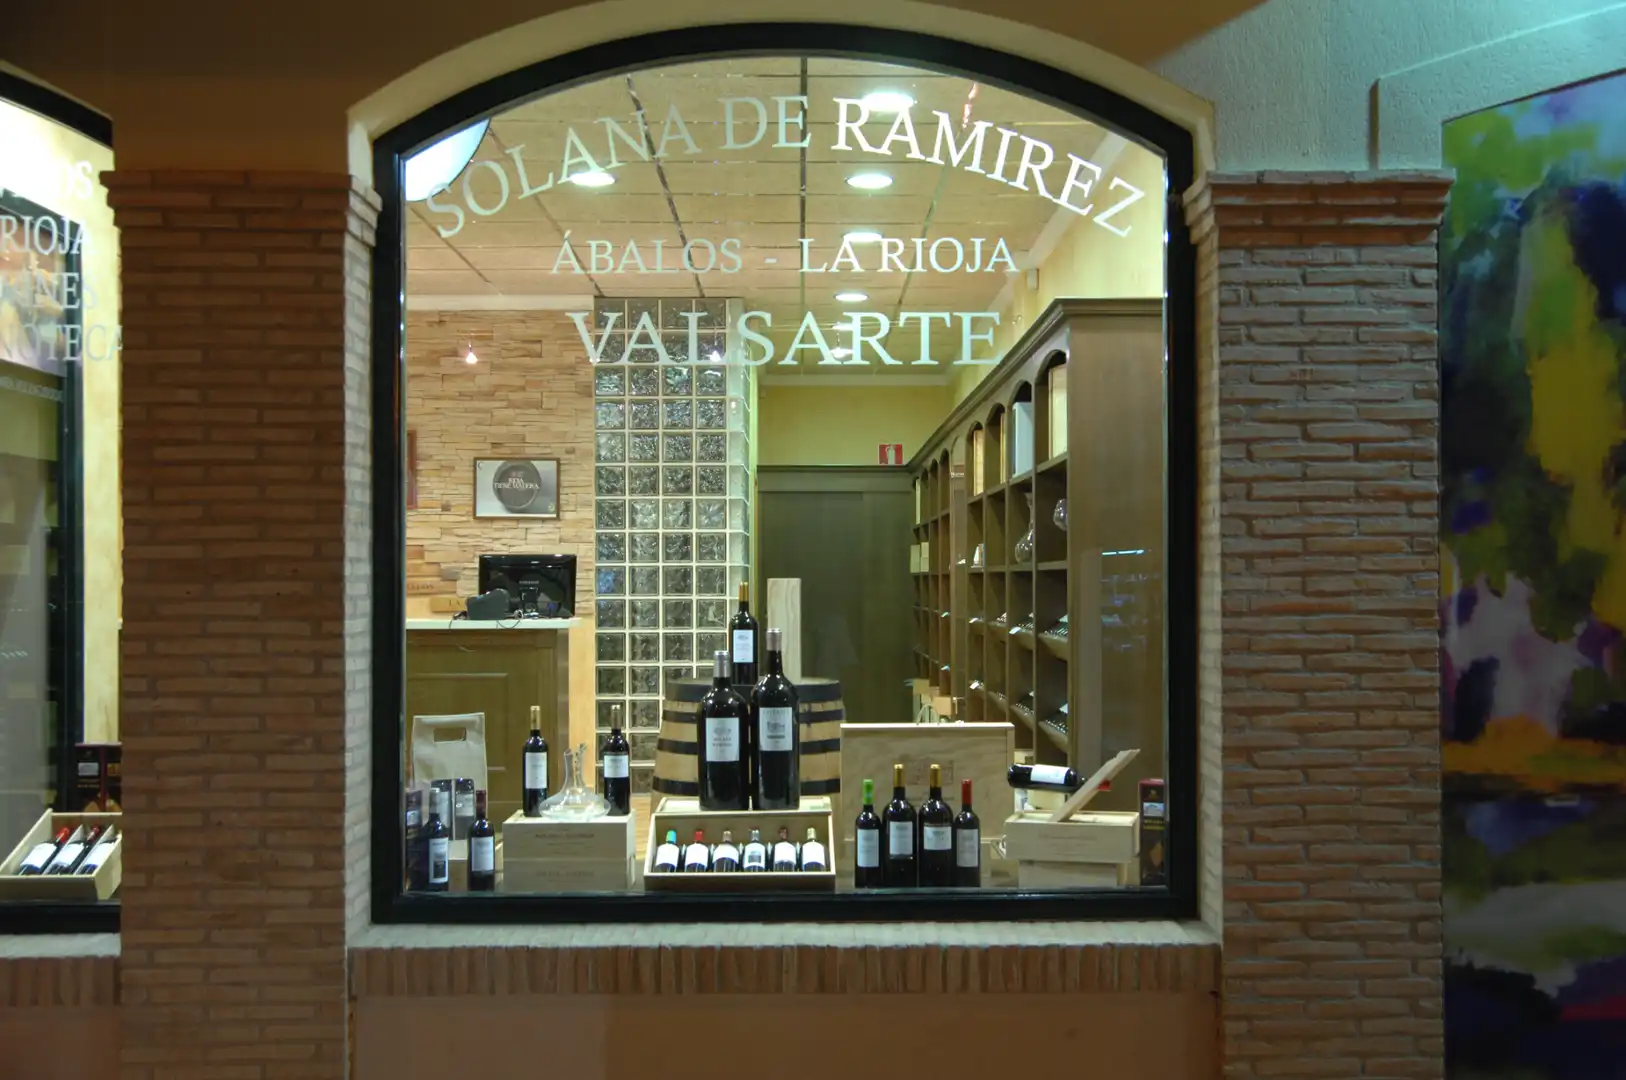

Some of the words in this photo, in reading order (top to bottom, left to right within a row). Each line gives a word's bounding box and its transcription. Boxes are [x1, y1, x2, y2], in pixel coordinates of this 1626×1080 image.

[426, 102, 702, 239] SOLANA
[717, 95, 812, 150] DE
[831, 97, 1145, 238] RAMIREZ
[551, 229, 742, 274] ÁBALOS
[797, 237, 864, 273] LA
[878, 237, 1019, 273] RIOJA
[565, 310, 1001, 366] VALSARTE
